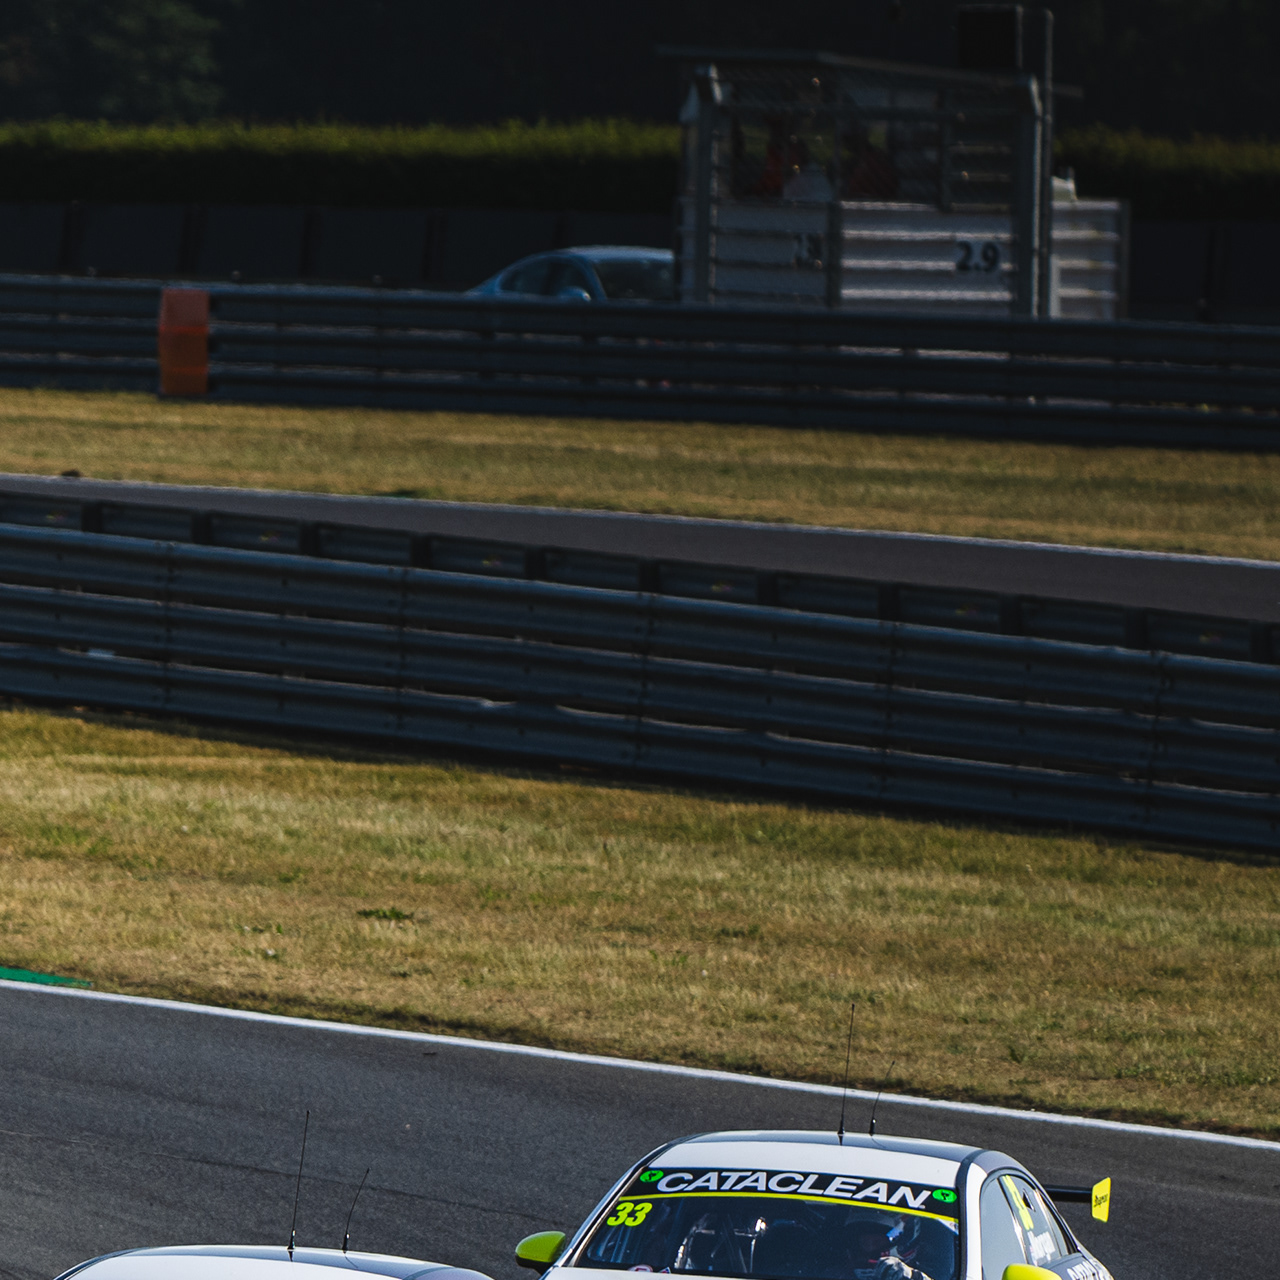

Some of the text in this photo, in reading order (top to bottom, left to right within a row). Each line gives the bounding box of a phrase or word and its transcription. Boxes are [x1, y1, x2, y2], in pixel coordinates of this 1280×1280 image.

[956, 240, 1001, 273] 2.9
[657, 1170, 926, 1208] CATACLEAN
[606, 1201, 653, 1227] 33
